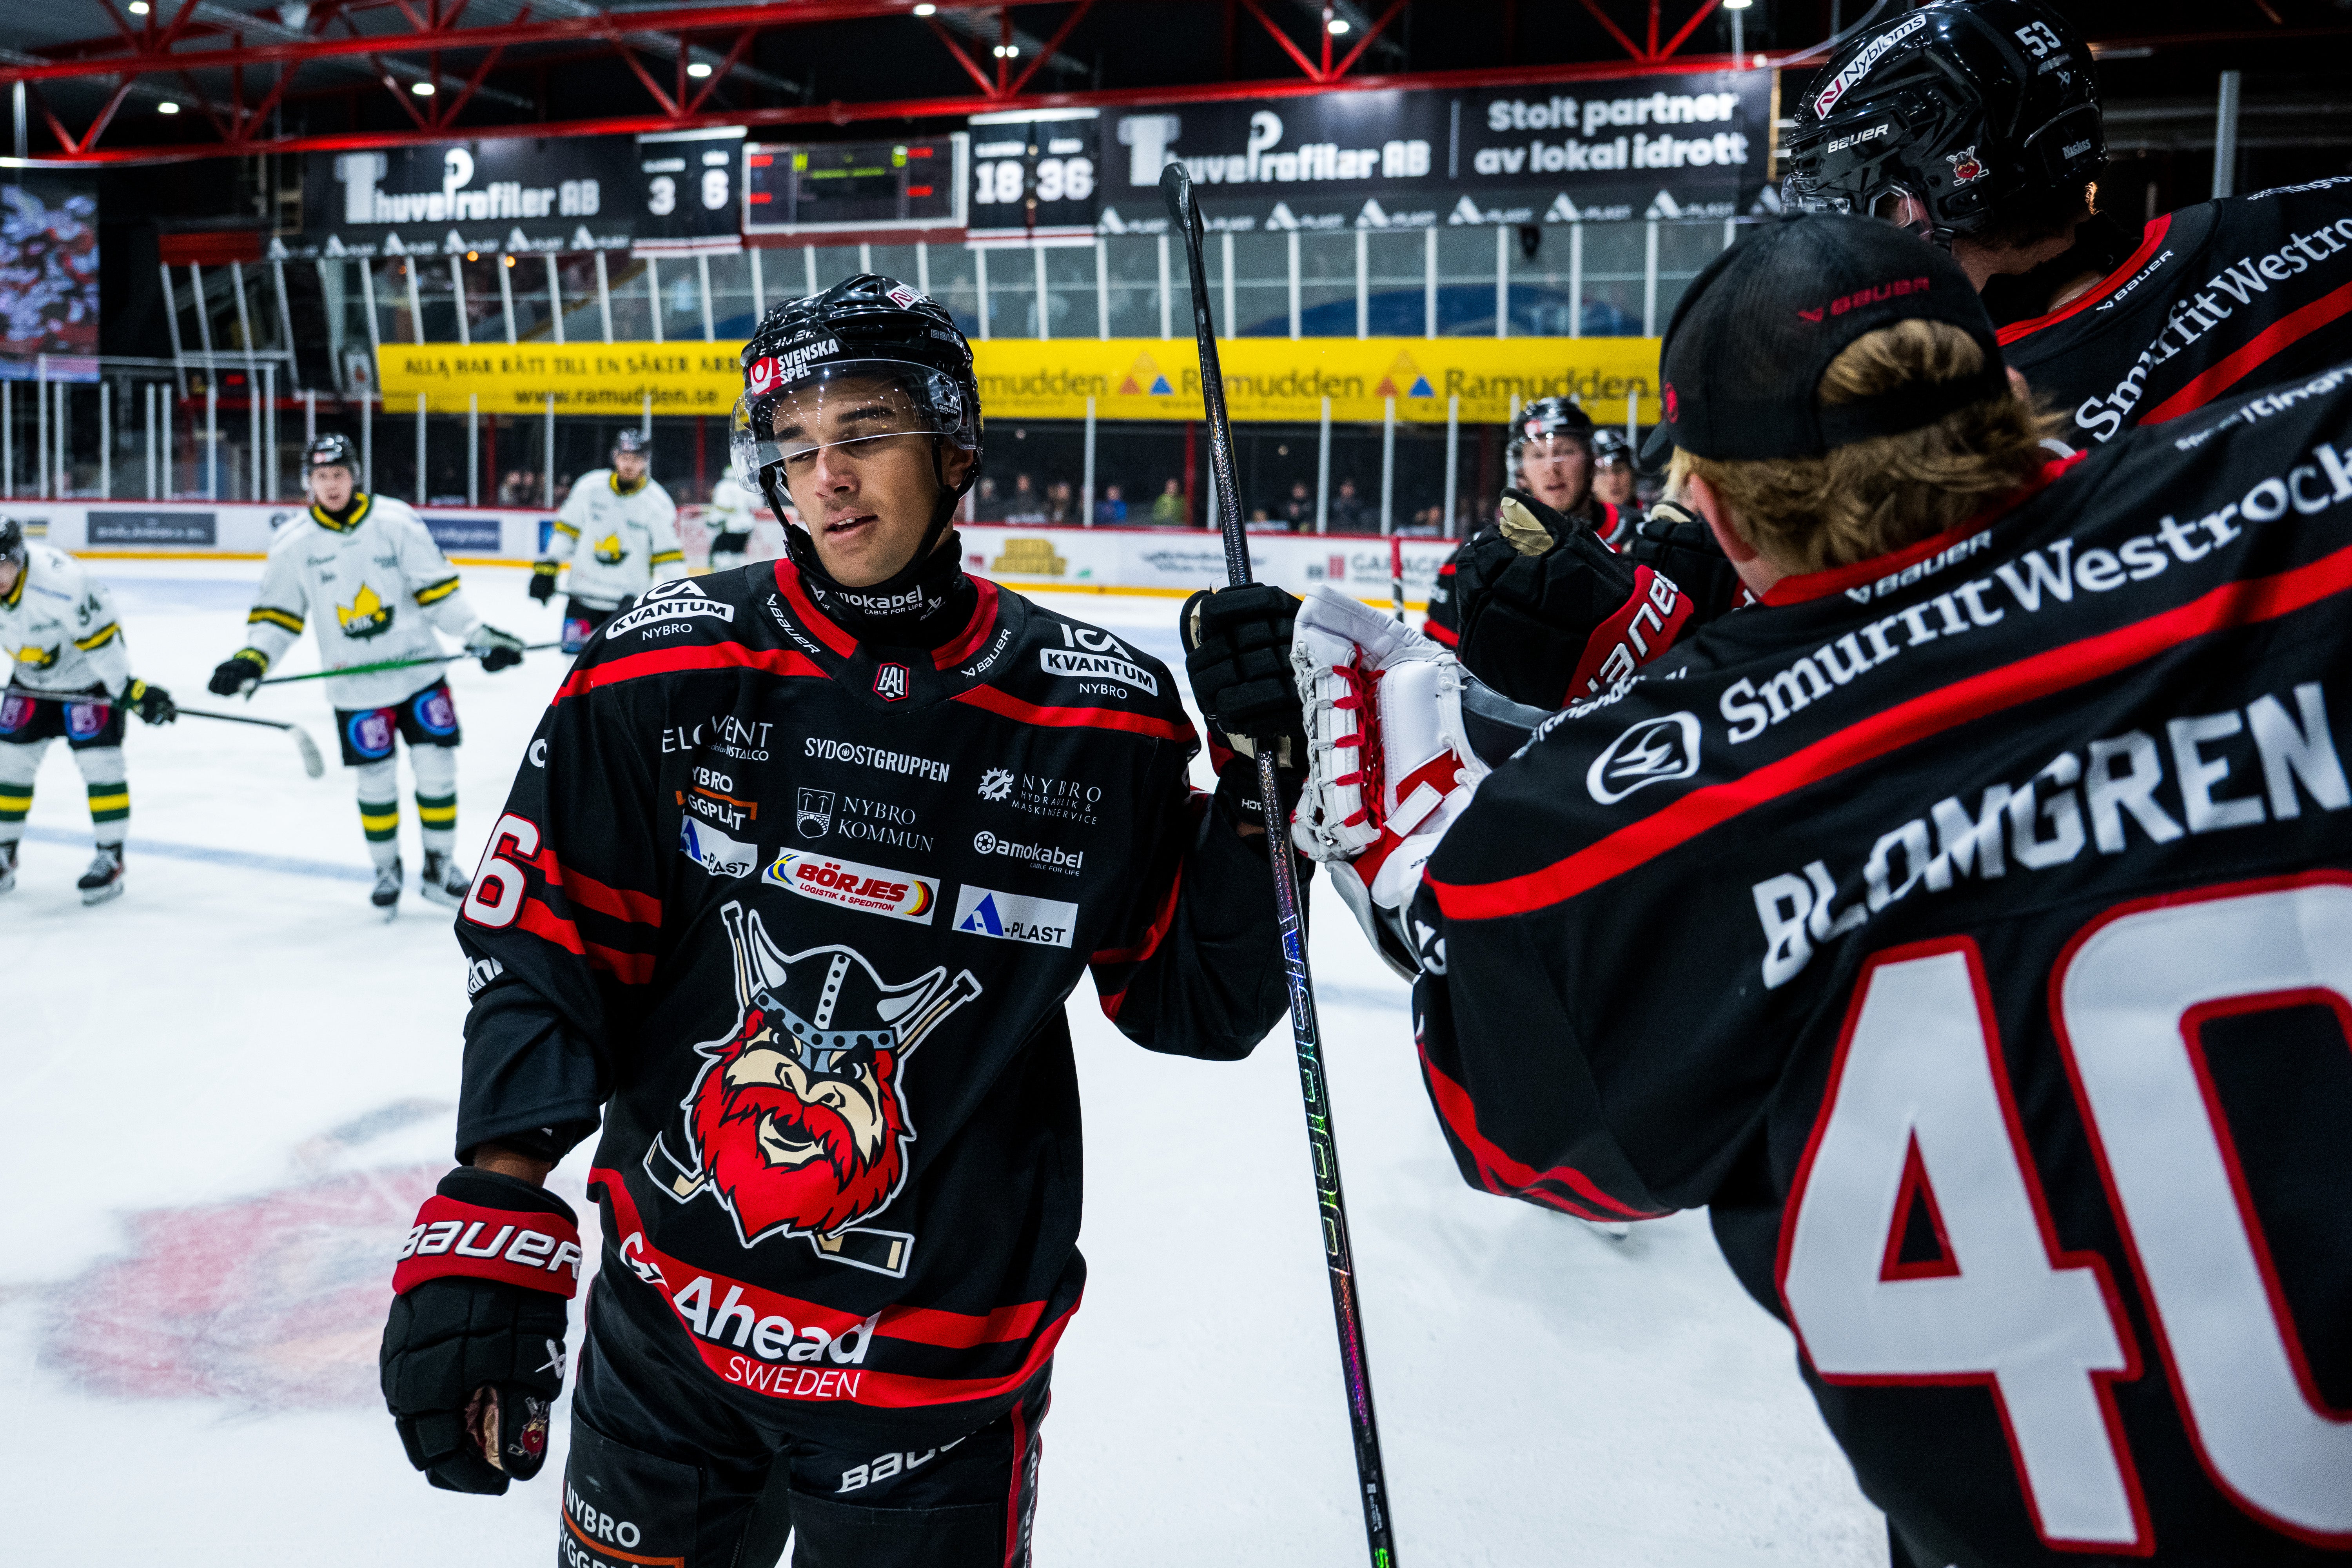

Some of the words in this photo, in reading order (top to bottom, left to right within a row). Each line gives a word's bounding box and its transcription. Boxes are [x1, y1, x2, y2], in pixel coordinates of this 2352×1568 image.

[1844, 16, 1923, 83] Nybloms
[2014, 21, 2061, 56] 53
[1488, 95, 1580, 132] Stolt
[1582, 92, 1739, 137] partner
[1382, 139, 1432, 178] AB
[1474, 146, 1526, 175] av
[1530, 136, 1629, 173] lokal
[1632, 131, 1748, 170] idrott
[647, 176, 675, 216] 3
[701, 169, 729, 211] 6
[975, 160, 1023, 204] 18
[1036, 157, 1094, 201] 36
[559, 178, 601, 217] AB
[2207, 217, 2352, 305] Westro
[777, 338, 839, 371] SVENSKA
[780, 363, 811, 385] SPEL
[978, 367, 1108, 396] mudden
[1181, 367, 1364, 398] Rmudden
[633, 580, 707, 609] ICA
[835, 584, 922, 608] mokabel
[908, 602, 923, 611] LIFE
[612, 601, 727, 633] KVANTUM
[642, 623, 693, 641] NYBRO
[1060, 623, 1134, 661] ICA
[1047, 653, 1153, 689] KVANTUM
[1079, 683, 1127, 699] NYBRO
[726, 744, 769, 761] INSTALCO
[805, 737, 950, 782] SYDOSTGRUPPEN
[692, 766, 733, 793] YBRO
[1023, 773, 1101, 802] NYBRO
[688, 794, 746, 831] GGPLÅT
[843, 797, 916, 825] NYBRO
[1012, 800, 1098, 825] MASKINSERVICE
[1021, 791, 1078, 809] HYDRAULIK
[838, 819, 934, 852] KOMMUN
[1753, 682, 2352, 991] BLOMGREN
[463, 813, 541, 929] 6
[996, 840, 1083, 869] amokabel
[1049, 865, 1062, 873] FOR
[795, 862, 909, 902] BÖRJES
[800, 882, 837, 900] LOGISTIK
[848, 896, 895, 912] SPEDITION
[1774, 868, 2352, 1558] 40
[673, 1276, 882, 1364] Ahead
[725, 1356, 861, 1397] SWEDEN
[566, 1481, 641, 1548] NYBRO
